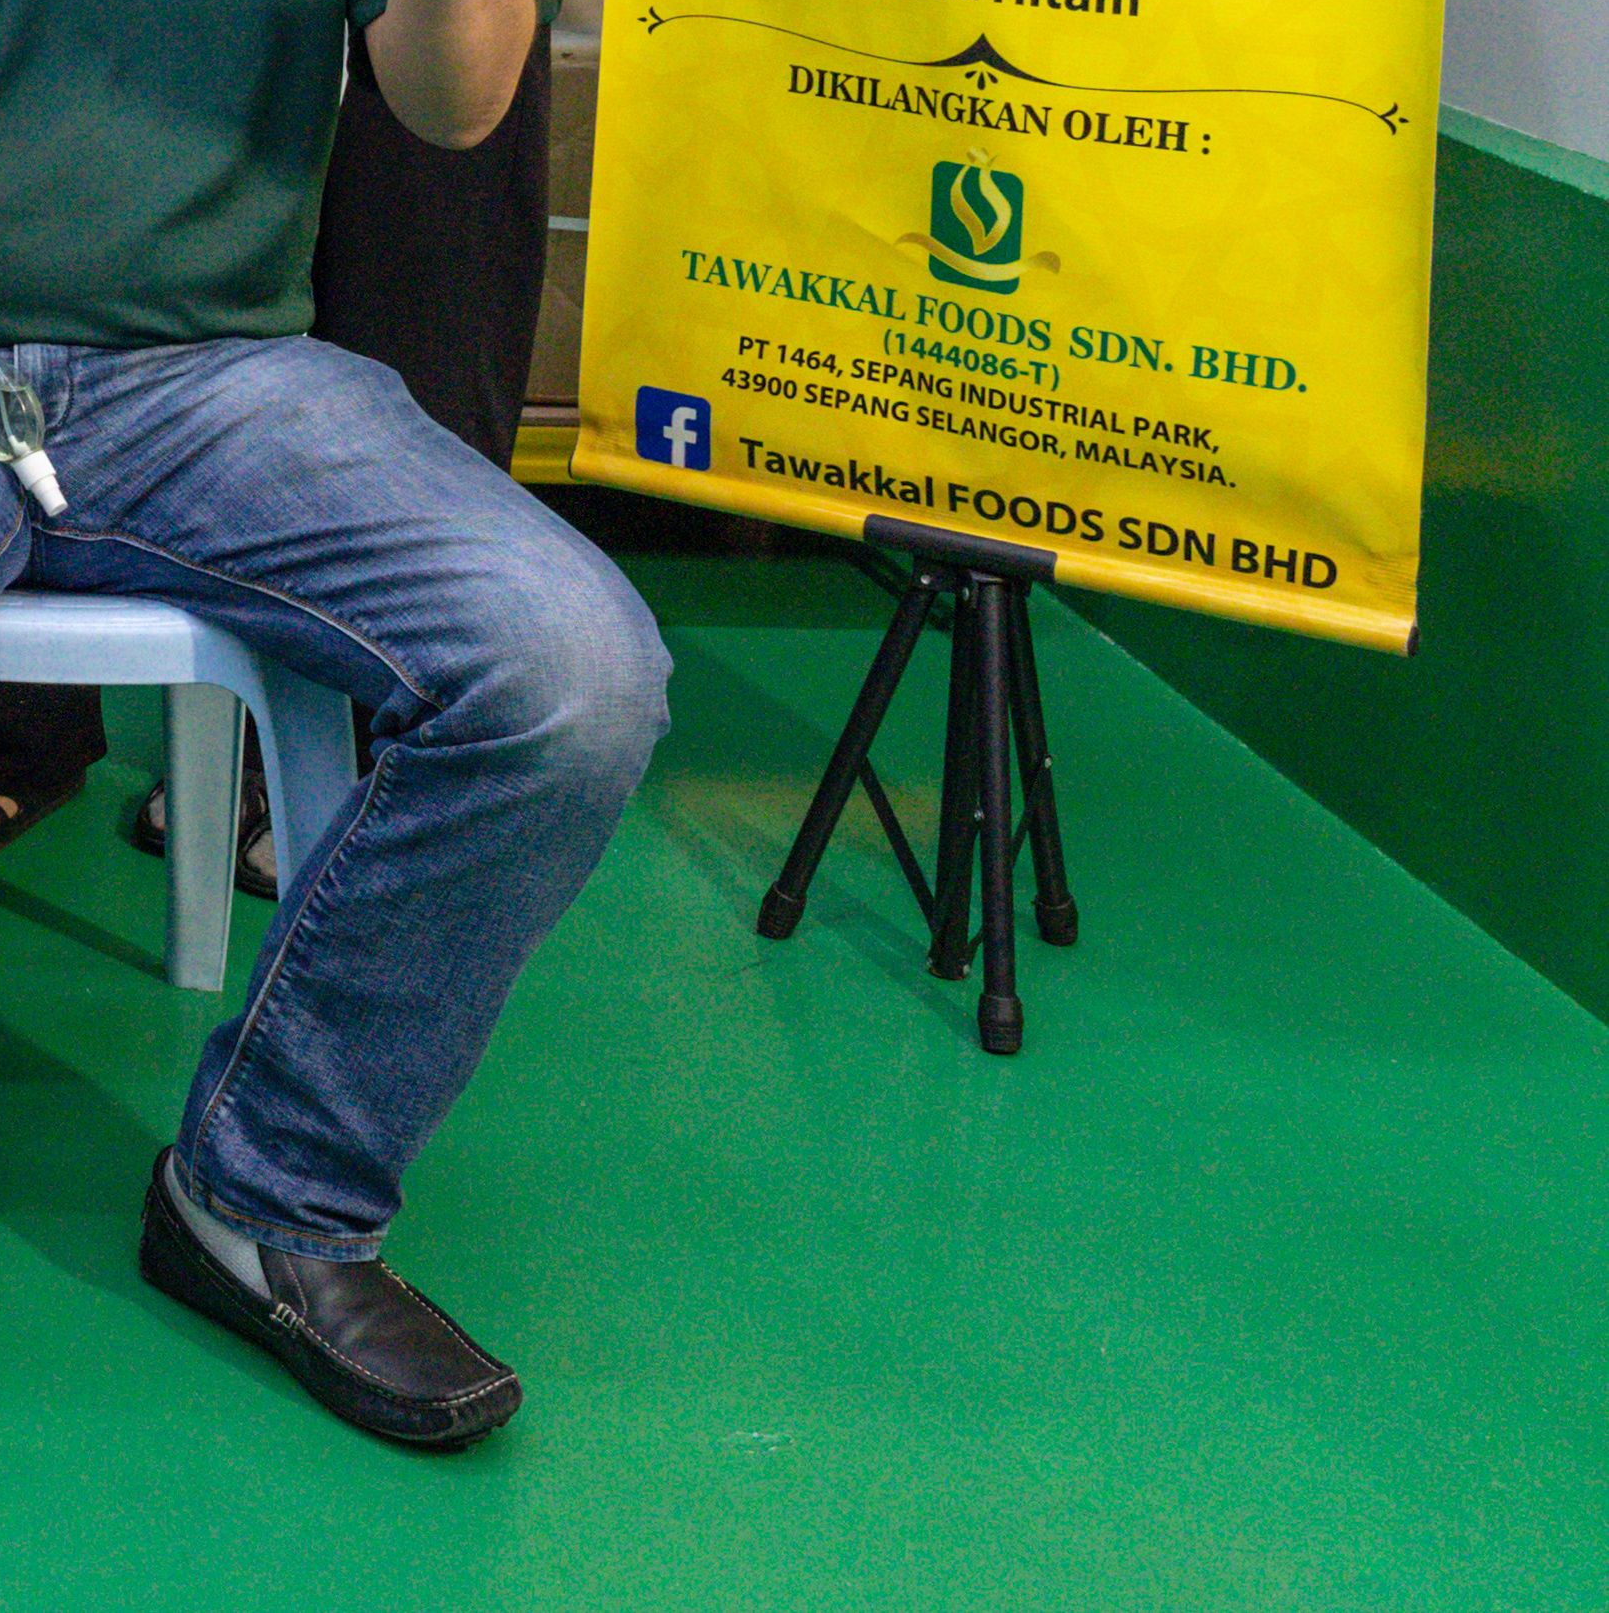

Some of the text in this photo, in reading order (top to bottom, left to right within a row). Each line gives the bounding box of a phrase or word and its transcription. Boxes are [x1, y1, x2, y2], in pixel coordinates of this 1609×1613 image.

[789, 65, 1051, 136] DIKILANGKAN
[1063, 110, 1189, 152] OLEH
[682, 250, 1306, 392] TAWAKKAL FOODS SDN. BHD.
[883, 329, 1061, 393] (1444086-T)
[721, 368, 1236, 488] 43900 SEPANG SELANGOR, MALAYSIA.
[739, 336, 1219, 454] PT 1464, SEPANG INDUSTRIAL PARK,
[739, 437, 1337, 589] Tawakkal FOODS SDN BHD
